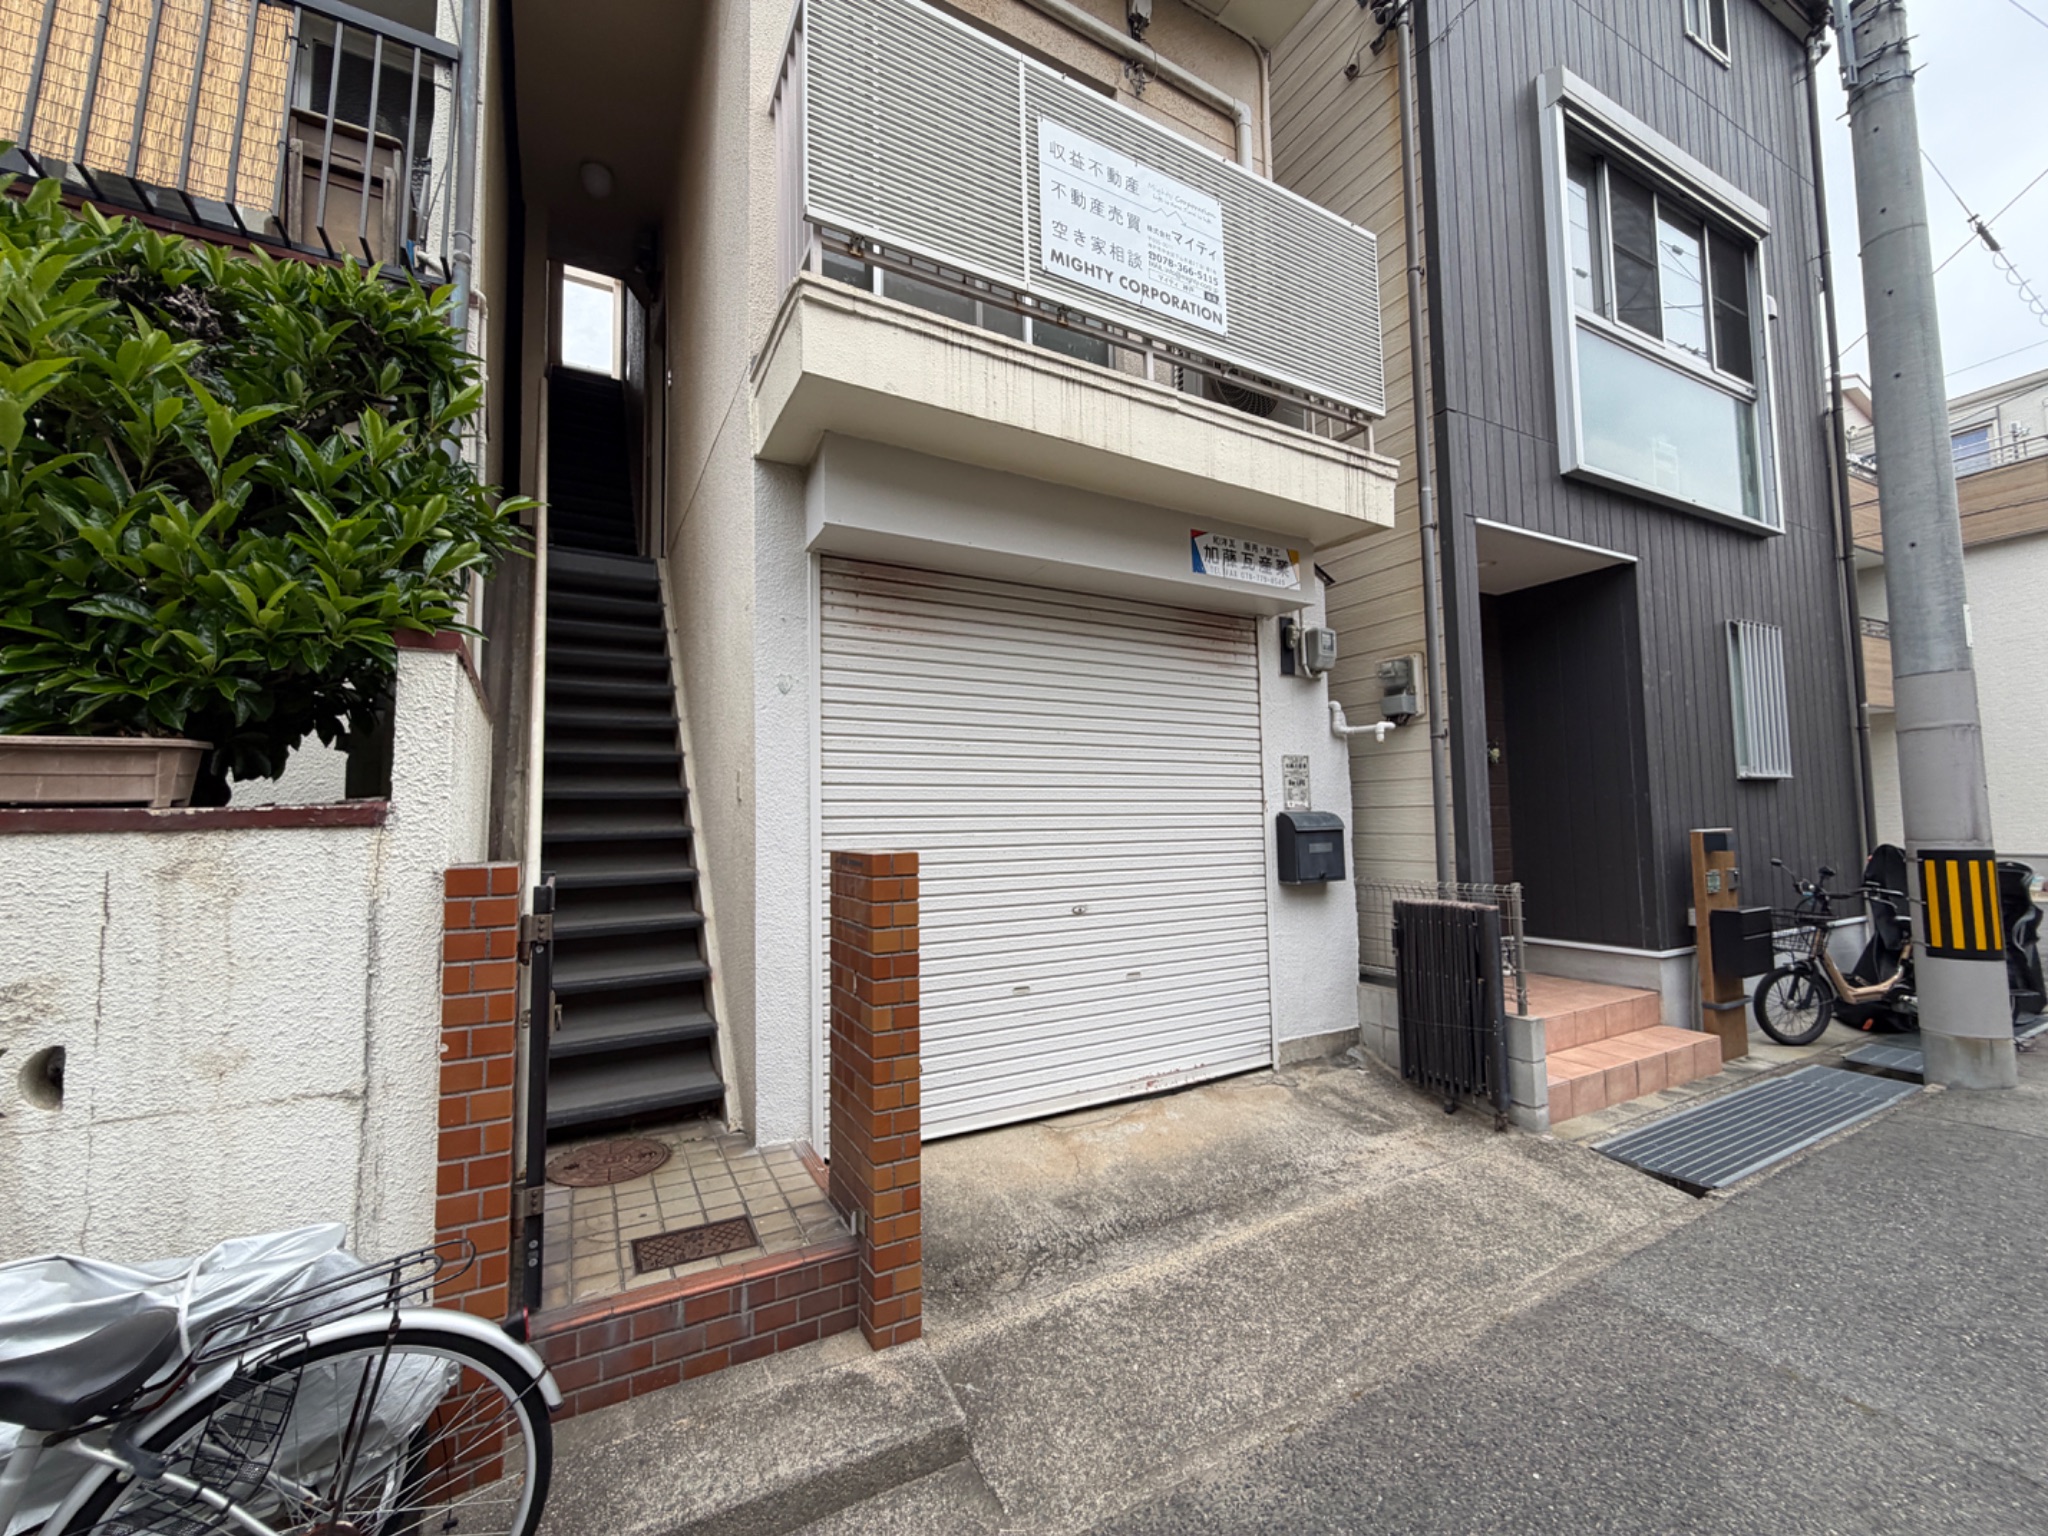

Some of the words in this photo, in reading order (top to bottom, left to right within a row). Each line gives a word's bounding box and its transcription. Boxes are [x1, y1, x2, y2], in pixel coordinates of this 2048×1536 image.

[1049, 140, 1140, 196] 収益不動産
[1050, 179, 1141, 234] 不動産売買
[1051, 219, 1143, 272] 空き家相談
[1050, 249, 1114, 284] MIGHTY
[1119, 274, 1223, 325] CORPORATION
[1203, 543, 1290, 578] 加藤瓦産業
